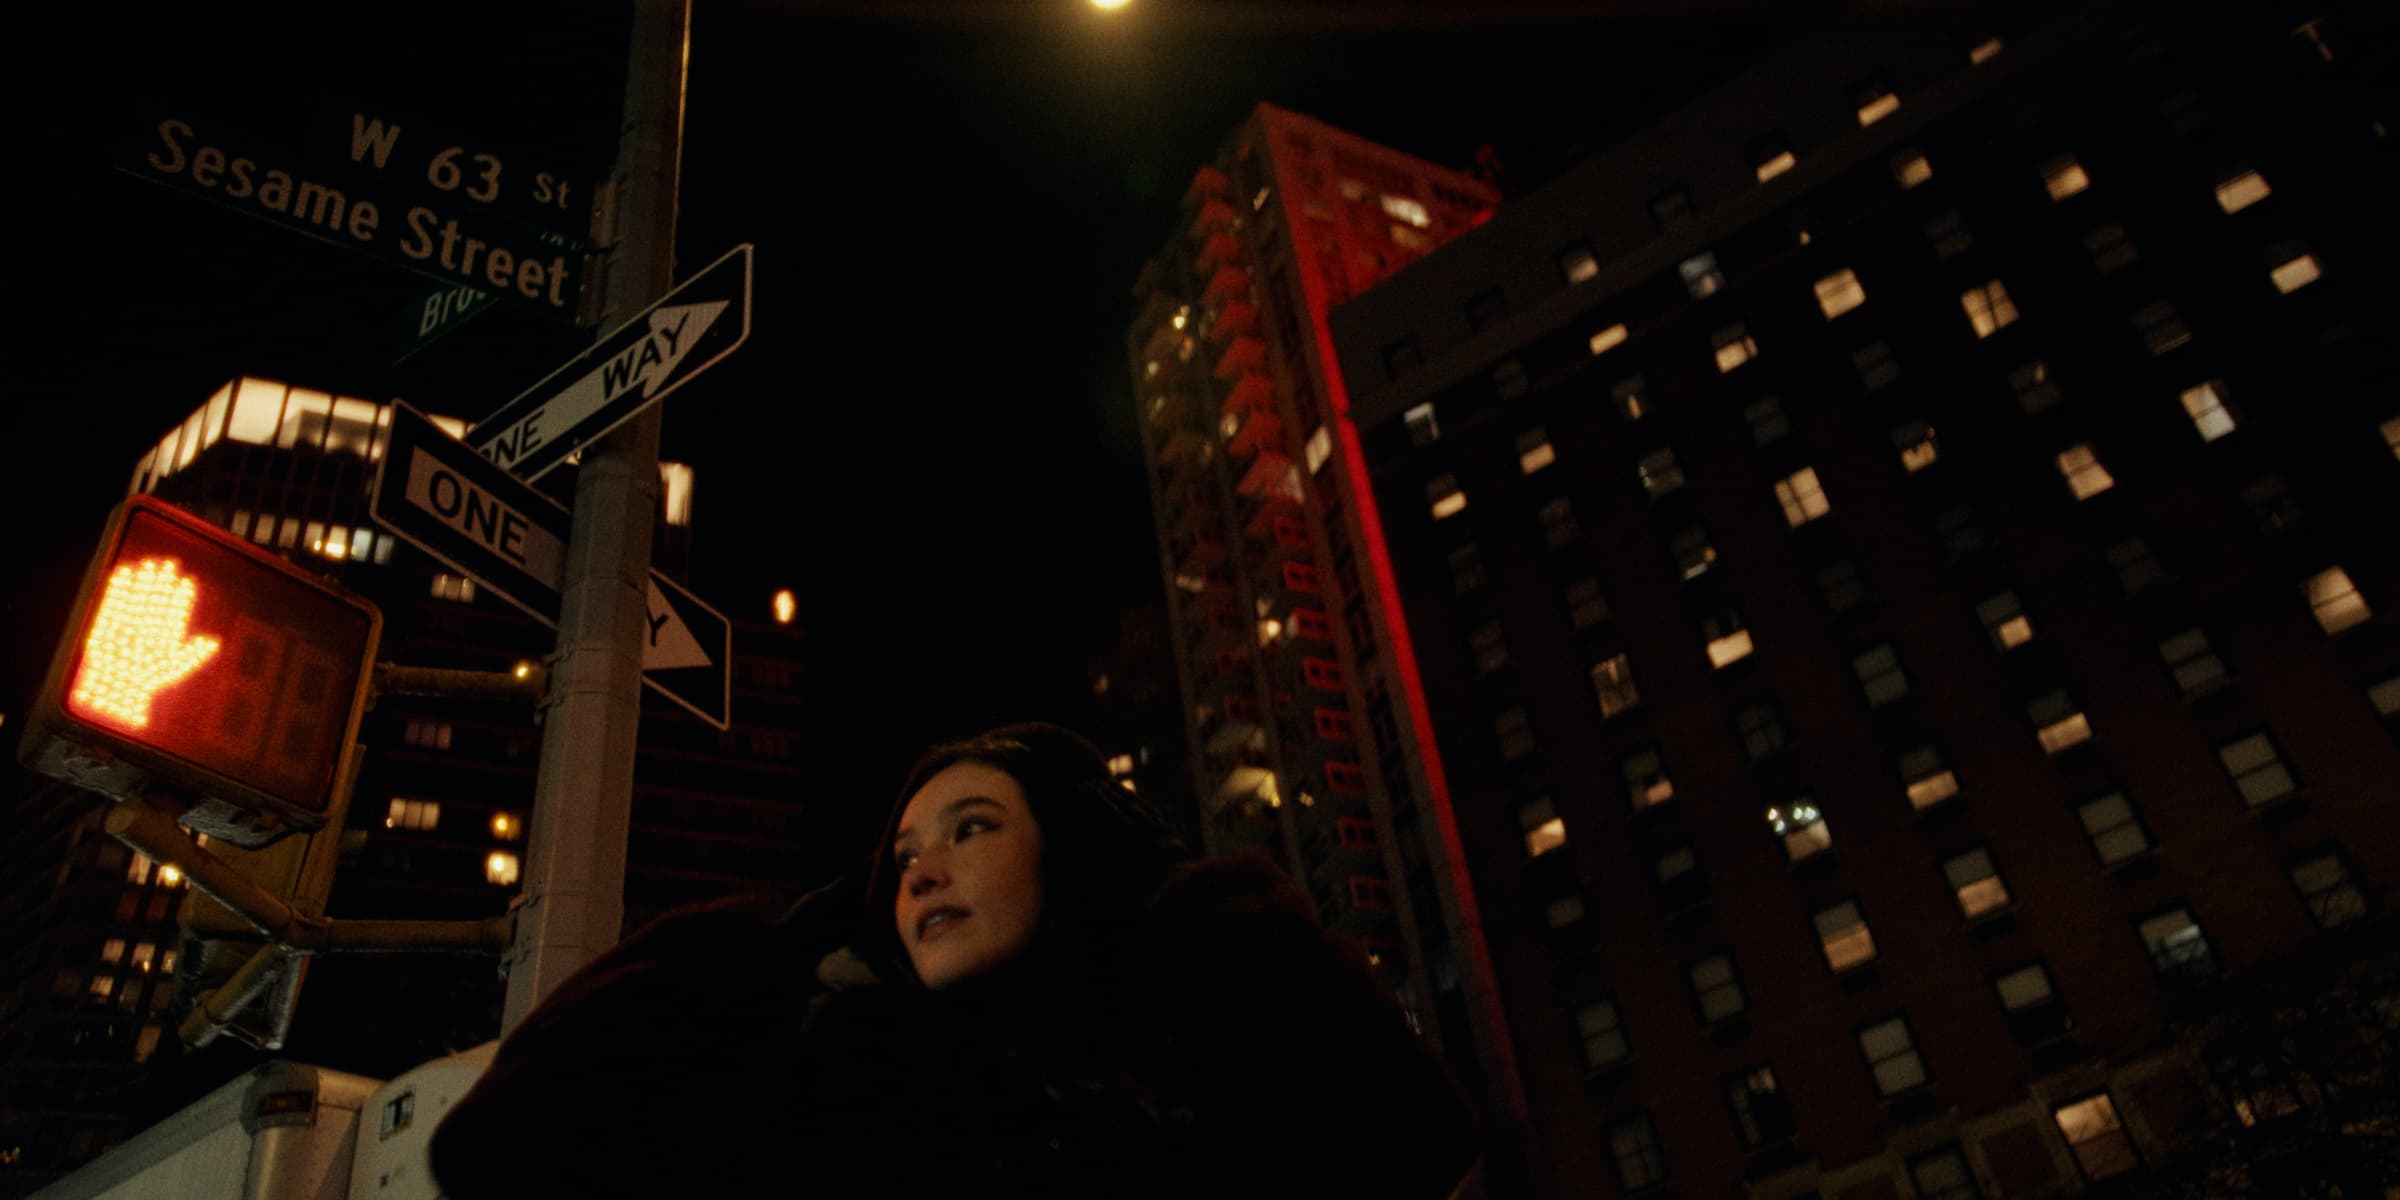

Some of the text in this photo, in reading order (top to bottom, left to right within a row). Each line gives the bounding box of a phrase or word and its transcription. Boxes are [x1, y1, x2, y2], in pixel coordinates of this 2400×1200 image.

[350, 112, 571, 211] W 63 St
[147, 117, 570, 308] Sesame Street
[418, 286, 487, 338] Bro
[482, 311, 690, 466] NE WAY
[430, 470, 529, 566] ONE
